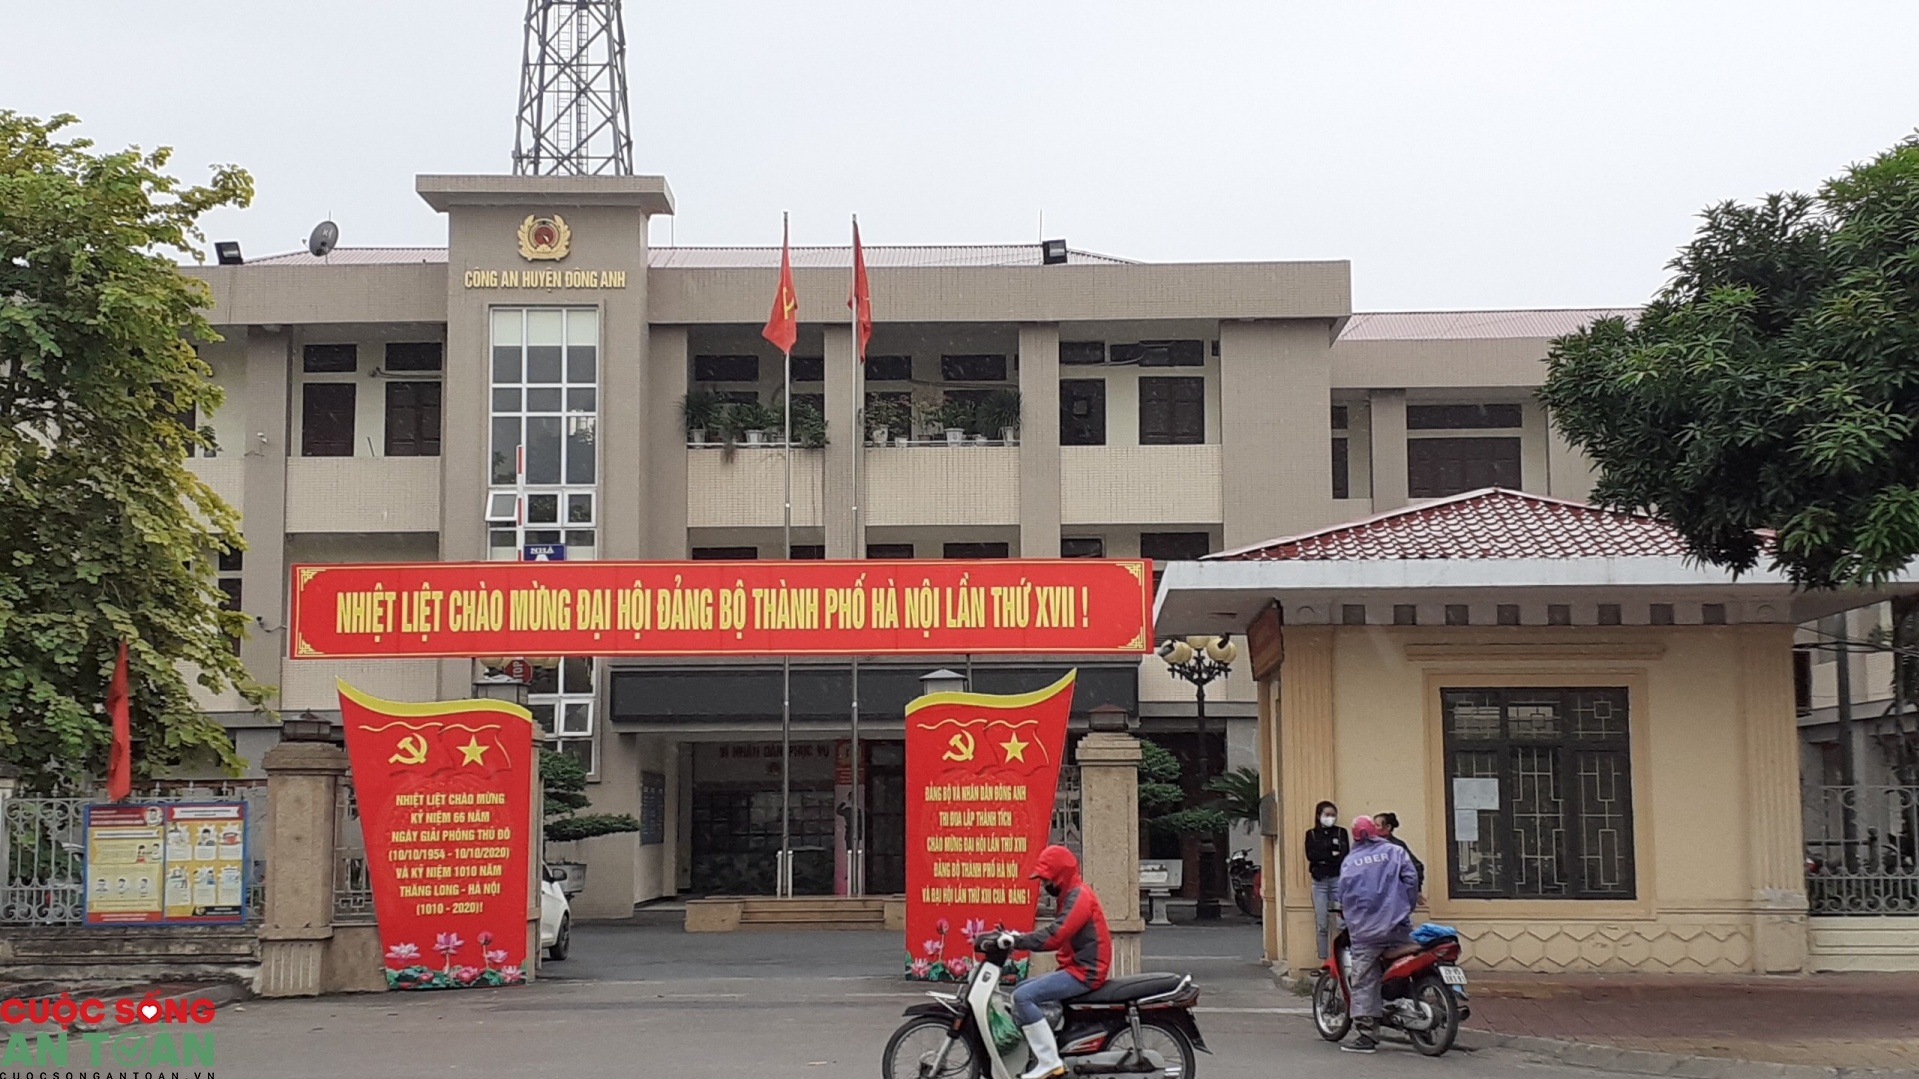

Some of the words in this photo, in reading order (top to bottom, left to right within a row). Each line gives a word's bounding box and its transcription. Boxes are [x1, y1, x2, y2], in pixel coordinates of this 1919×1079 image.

[464, 266, 498, 288] CÔNG
[501, 270, 519, 288] AN
[522, 267, 562, 293] HUYỆN
[565, 267, 598, 288] ĐÔNG
[600, 270, 626, 288] ANH
[336, 582, 396, 643] NHIỆT
[402, 582, 444, 642] LIỆT
[448, 580, 504, 632] CHÀO
[509, 580, 572, 631] MỪNG
[576, 589, 611, 641] ĐẠI
[617, 579, 651, 640] HỘI
[657, 574, 713, 630] ĐẢNG
[719, 579, 747, 640] BỘ
[752, 579, 819, 630] THÀNH
[825, 572, 867, 629] PHỐ
[871, 578, 899, 629] HÀ
[904, 578, 940, 638] NỘI
[946, 572, 985, 628] LẦN
[991, 578, 1033, 628] THỨ
[1035, 585, 1075, 628] XVII
[1082, 586, 1089, 628] !
[396, 792, 424, 808] NHIỆT
[426, 792, 447, 808] LIỆT
[448, 792, 474, 805] CHÀO
[476, 791, 505, 805] MỪNG
[411, 809, 424, 824] KỶ
[426, 810, 451, 826] NIỆM
[453, 812, 465, 823] 66
[468, 810, 490, 822] NĂM
[391, 829, 418, 842] NGÀY
[420, 826, 440, 842] GIẢI
[442, 827, 475, 841] PHÓNG
[477, 825, 495, 840] THỦ
[497, 826, 511, 840] ĐÔ
[389, 848, 445, 861] (10/10/1954
[455, 847, 510, 859] 10/10/2020)
[1354, 853, 1390, 866] UBER
[396, 865, 409, 879] VÀ
[411, 863, 424, 878] KỶ
[426, 865, 452, 880] NIỆM
[454, 865, 477, 877] 1010
[479, 863, 502, 876] NĂM
[399, 883, 432, 897] THĂNG
[434, 884, 459, 896] LONG
[468, 881, 480, 895] HÀ
[483, 881, 501, 896] NỘI
[416, 903, 444, 916] (1010
[452, 902, 484, 914] 2020)!
